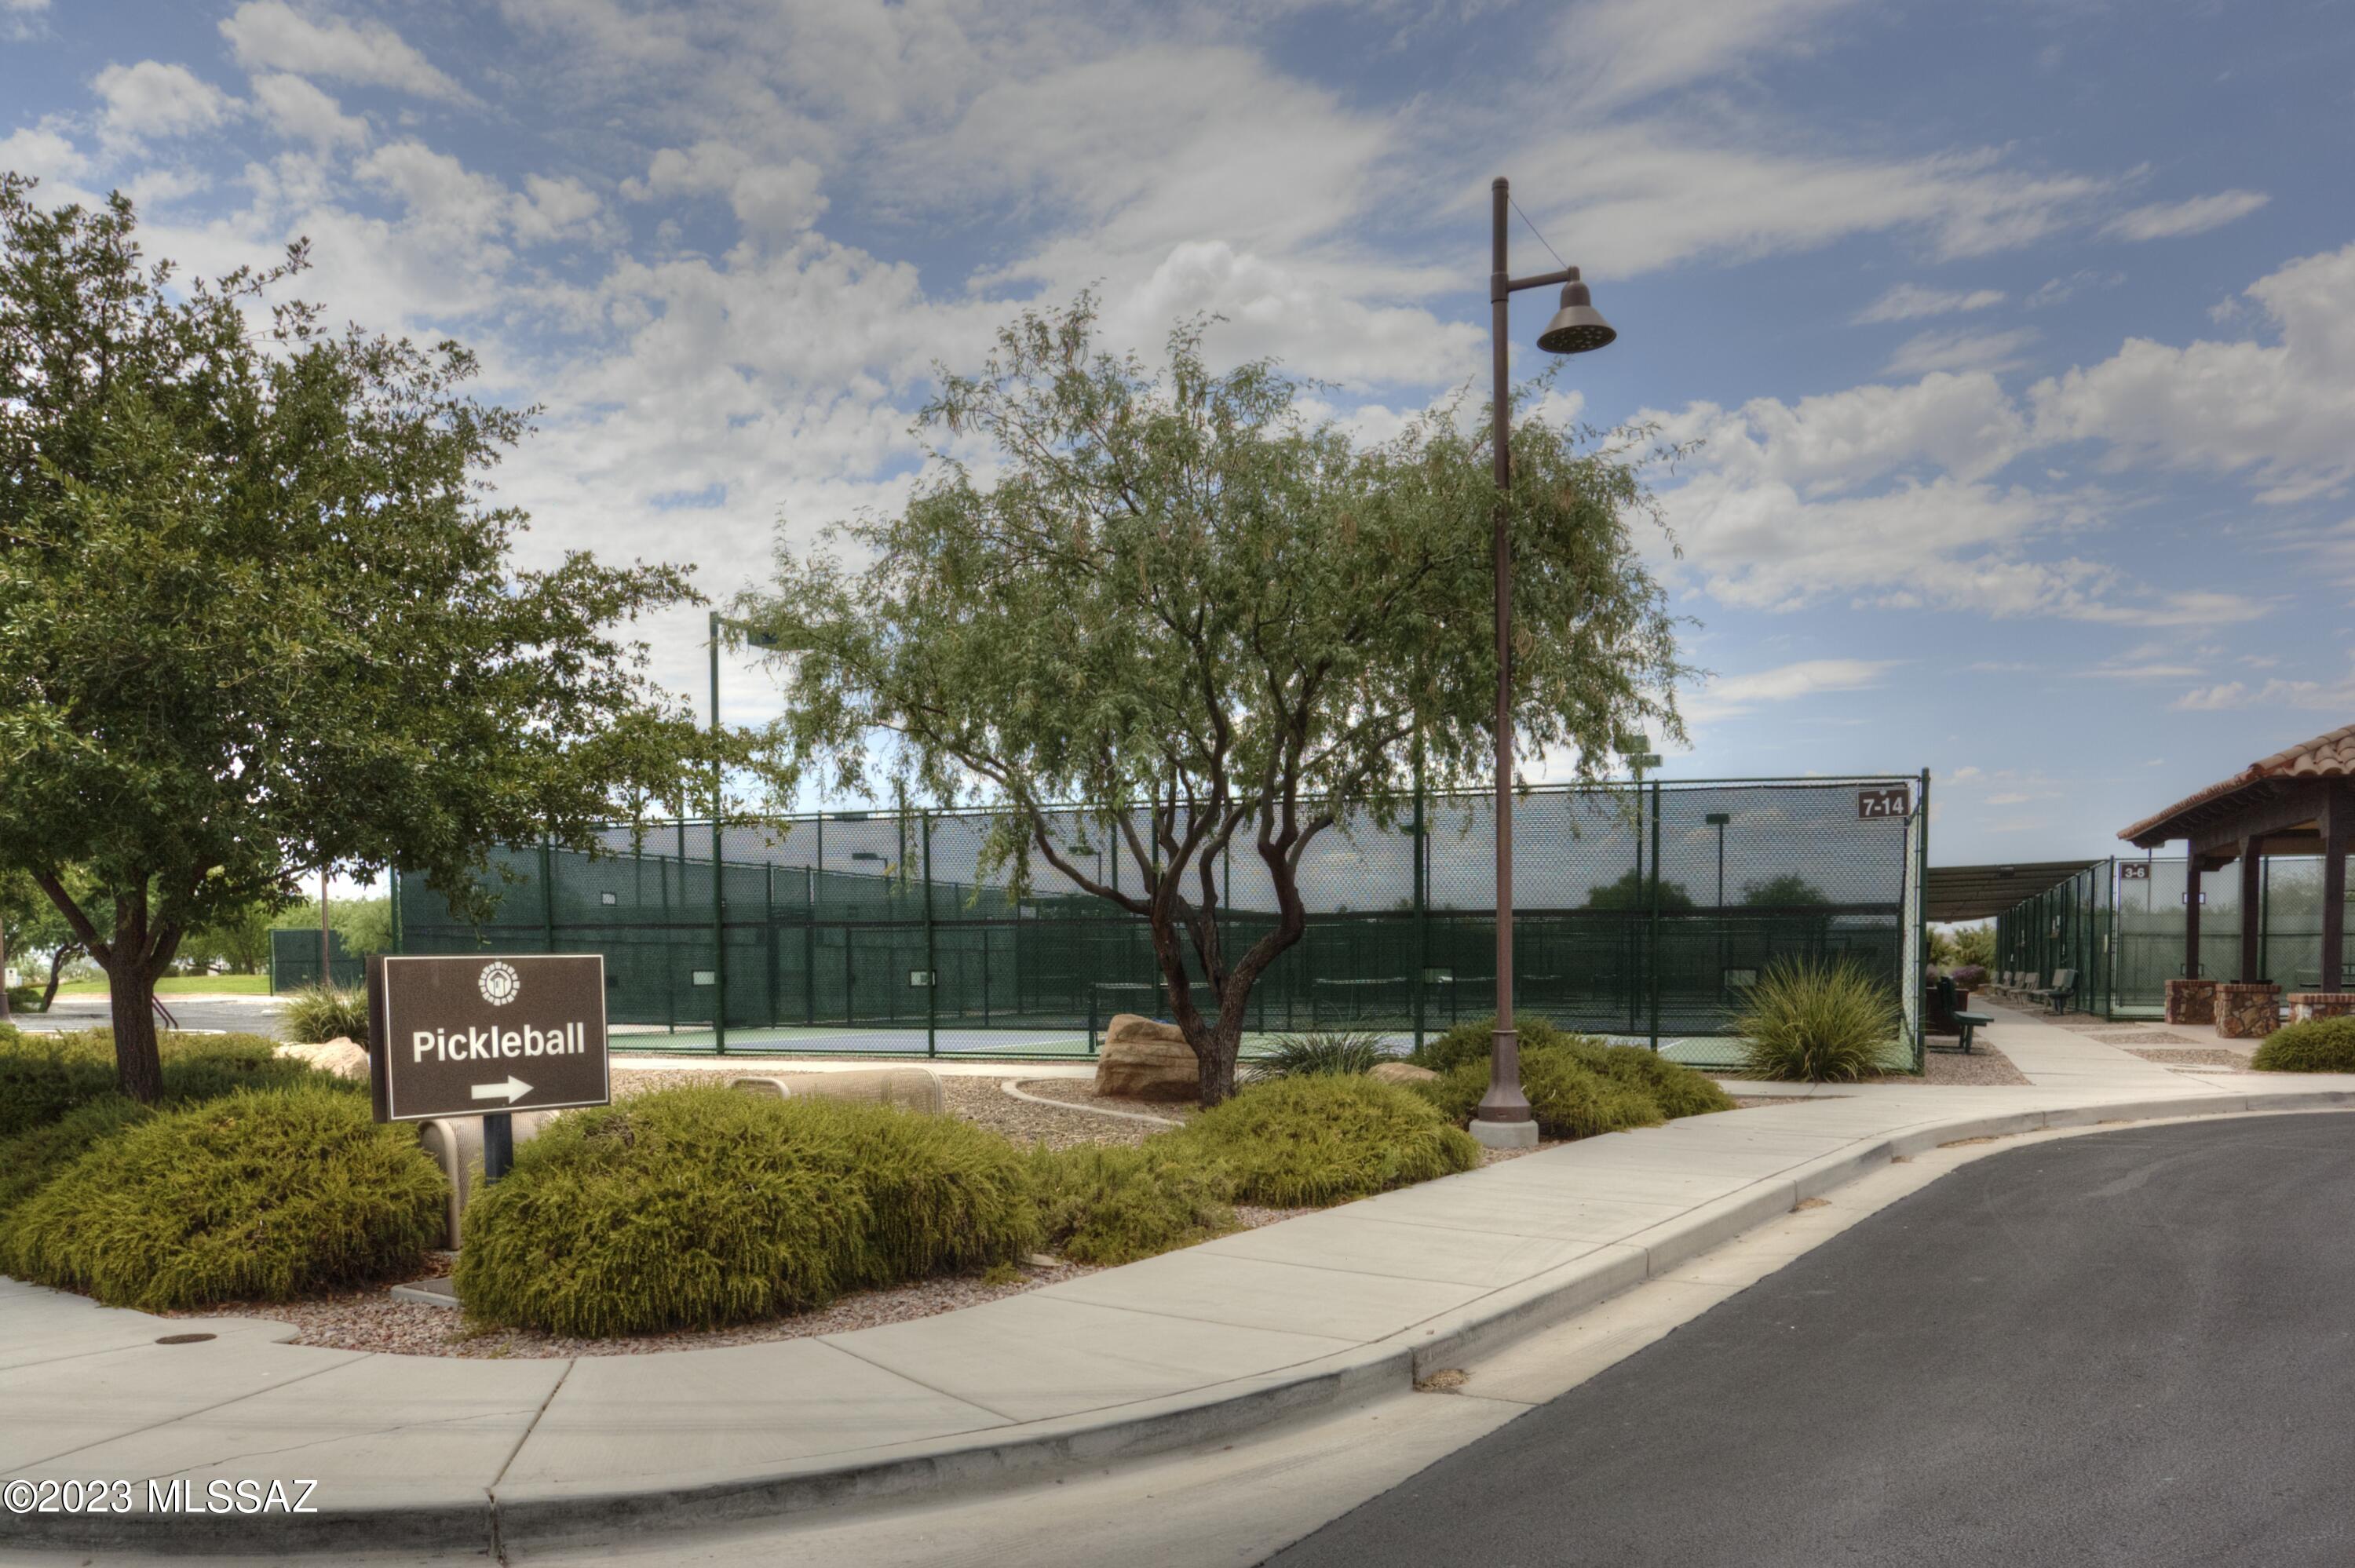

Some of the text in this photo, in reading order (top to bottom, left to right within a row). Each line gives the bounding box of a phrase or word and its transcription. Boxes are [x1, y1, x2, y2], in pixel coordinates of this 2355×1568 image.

[1863, 797, 1904, 815] 7-14
[2125, 867, 2145, 877] 3-6
[413, 1022, 584, 1063] Pickleball
